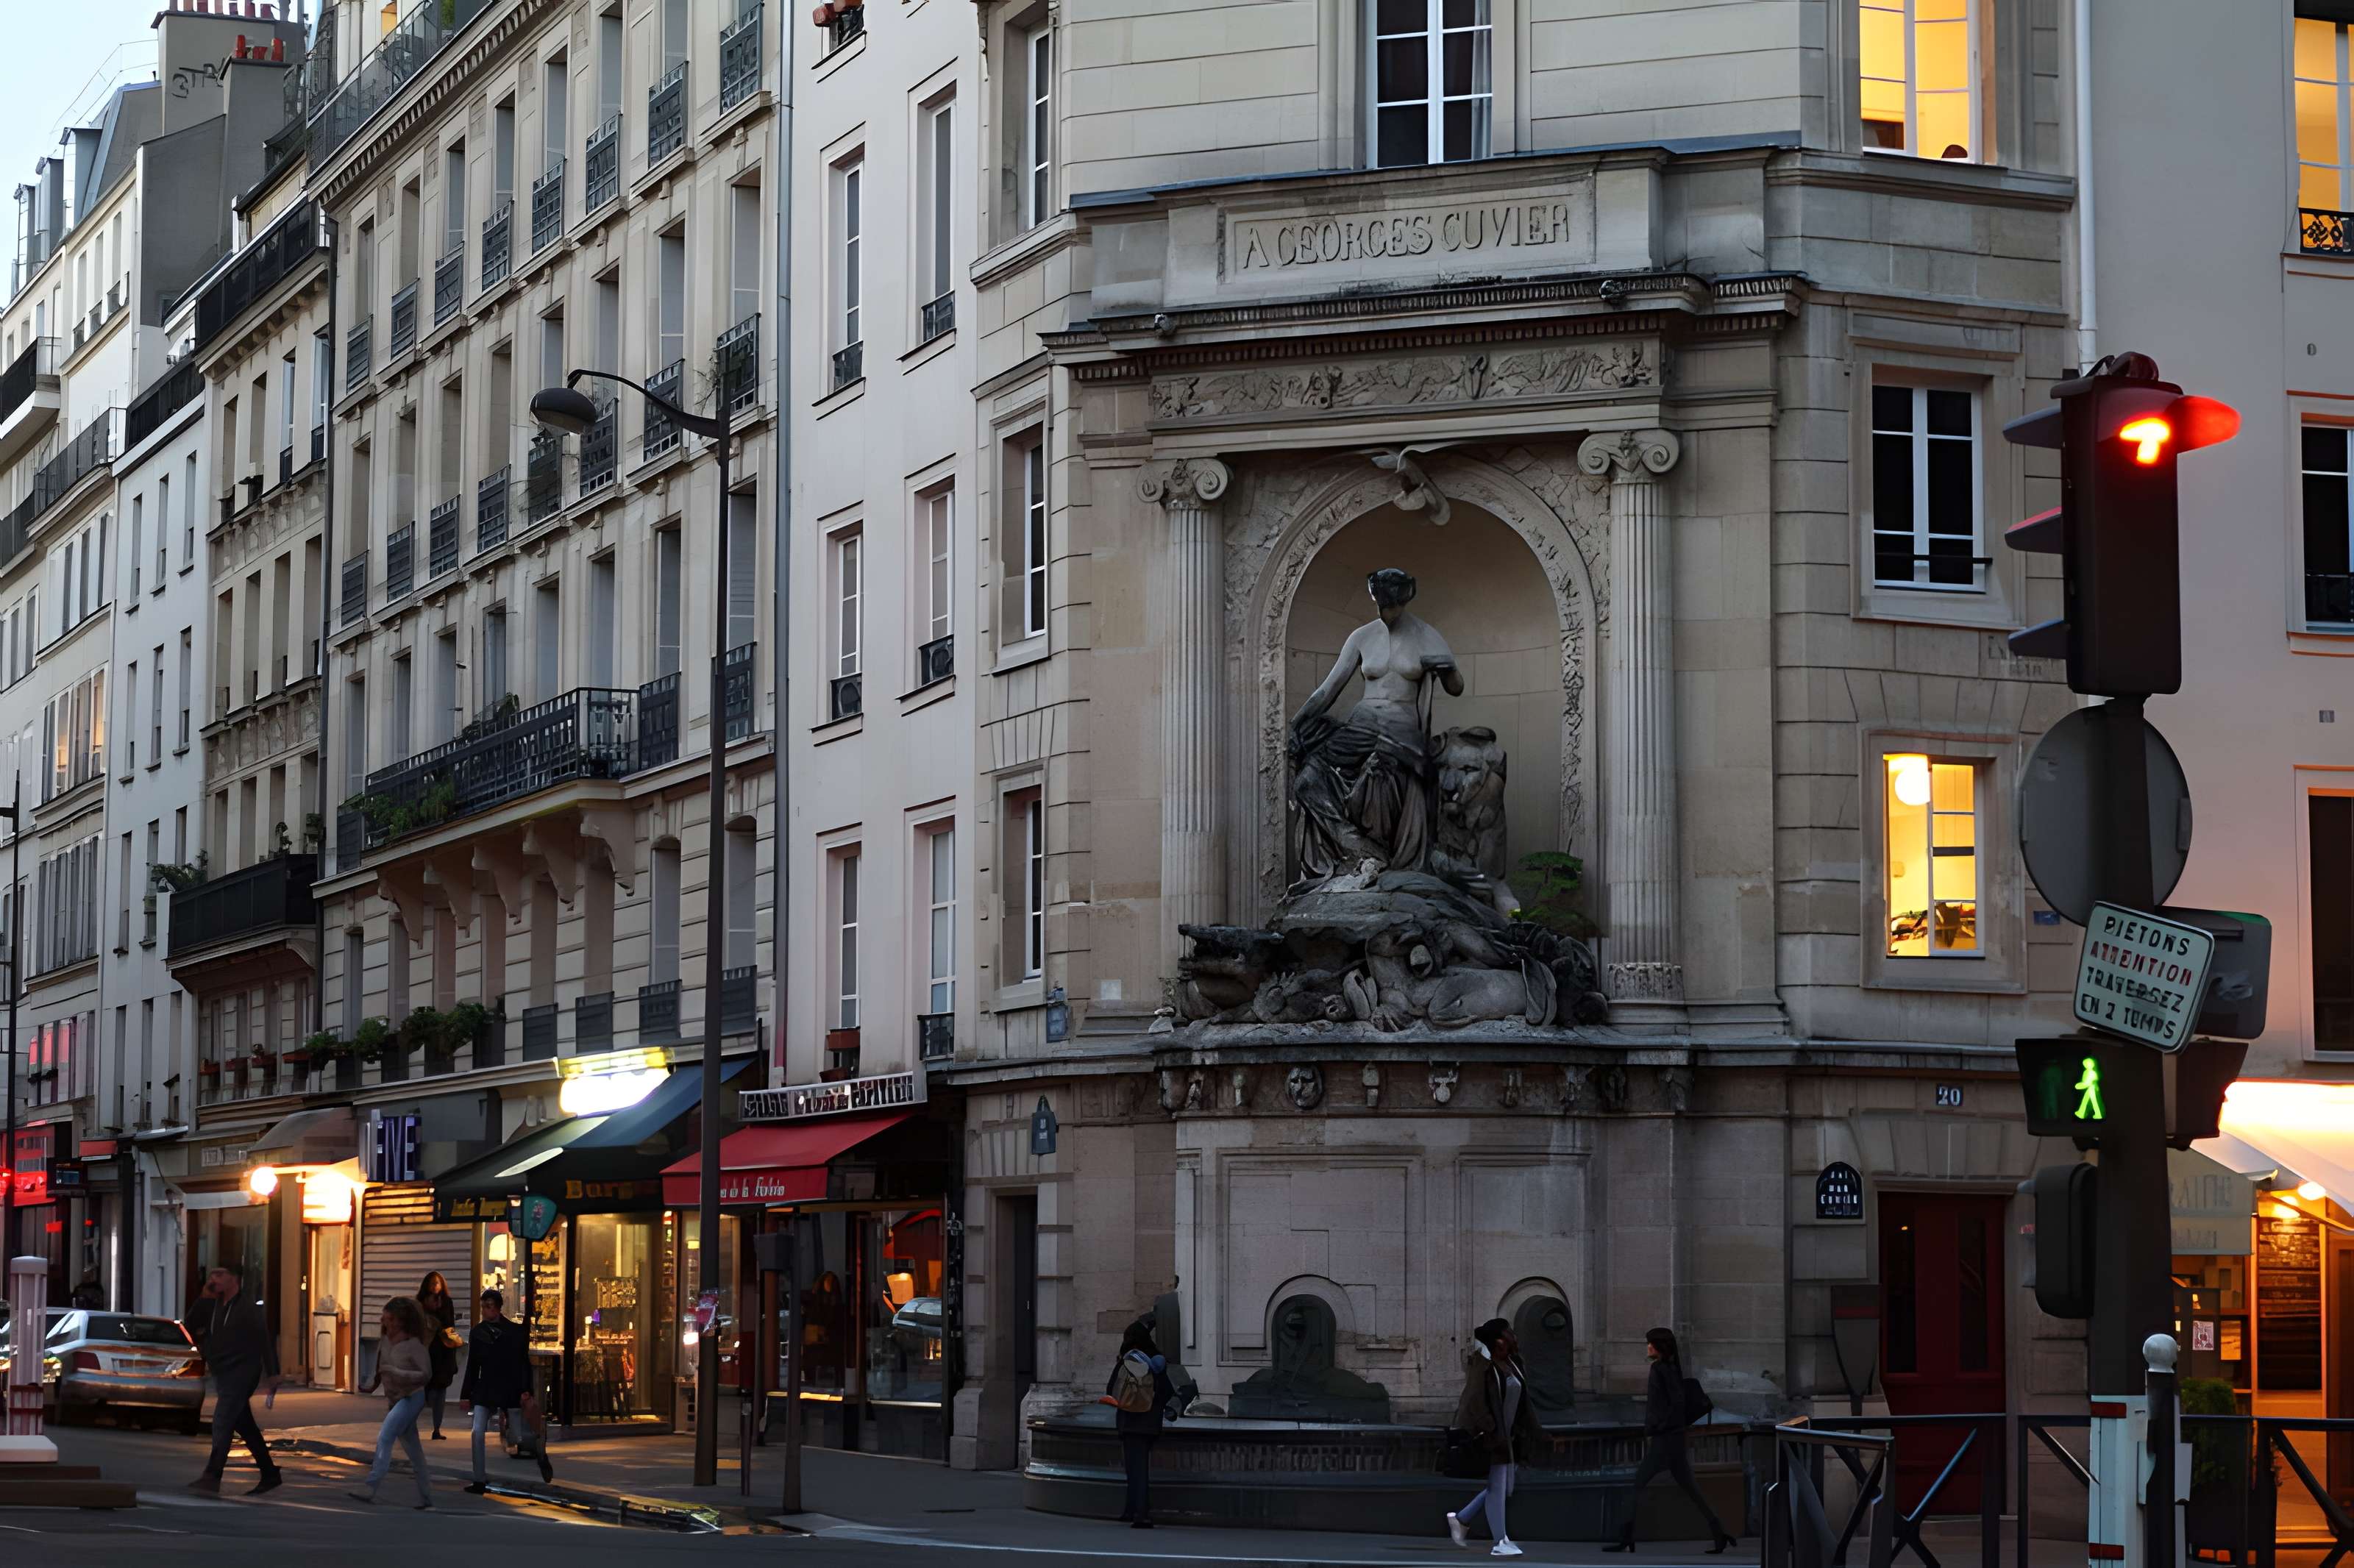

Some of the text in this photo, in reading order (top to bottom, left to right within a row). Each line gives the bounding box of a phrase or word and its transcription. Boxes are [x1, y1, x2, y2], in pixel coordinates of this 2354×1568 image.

[1242, 204, 1569, 269] A GEORGES CUVIER
[2104, 916, 2191, 956] PIETONS
[2090, 941, 2192, 986] ATTENTION
[2080, 994, 2100, 1015] EN
[2105, 1002, 2116, 1021] 2
[1938, 1086, 1960, 1105] 20
